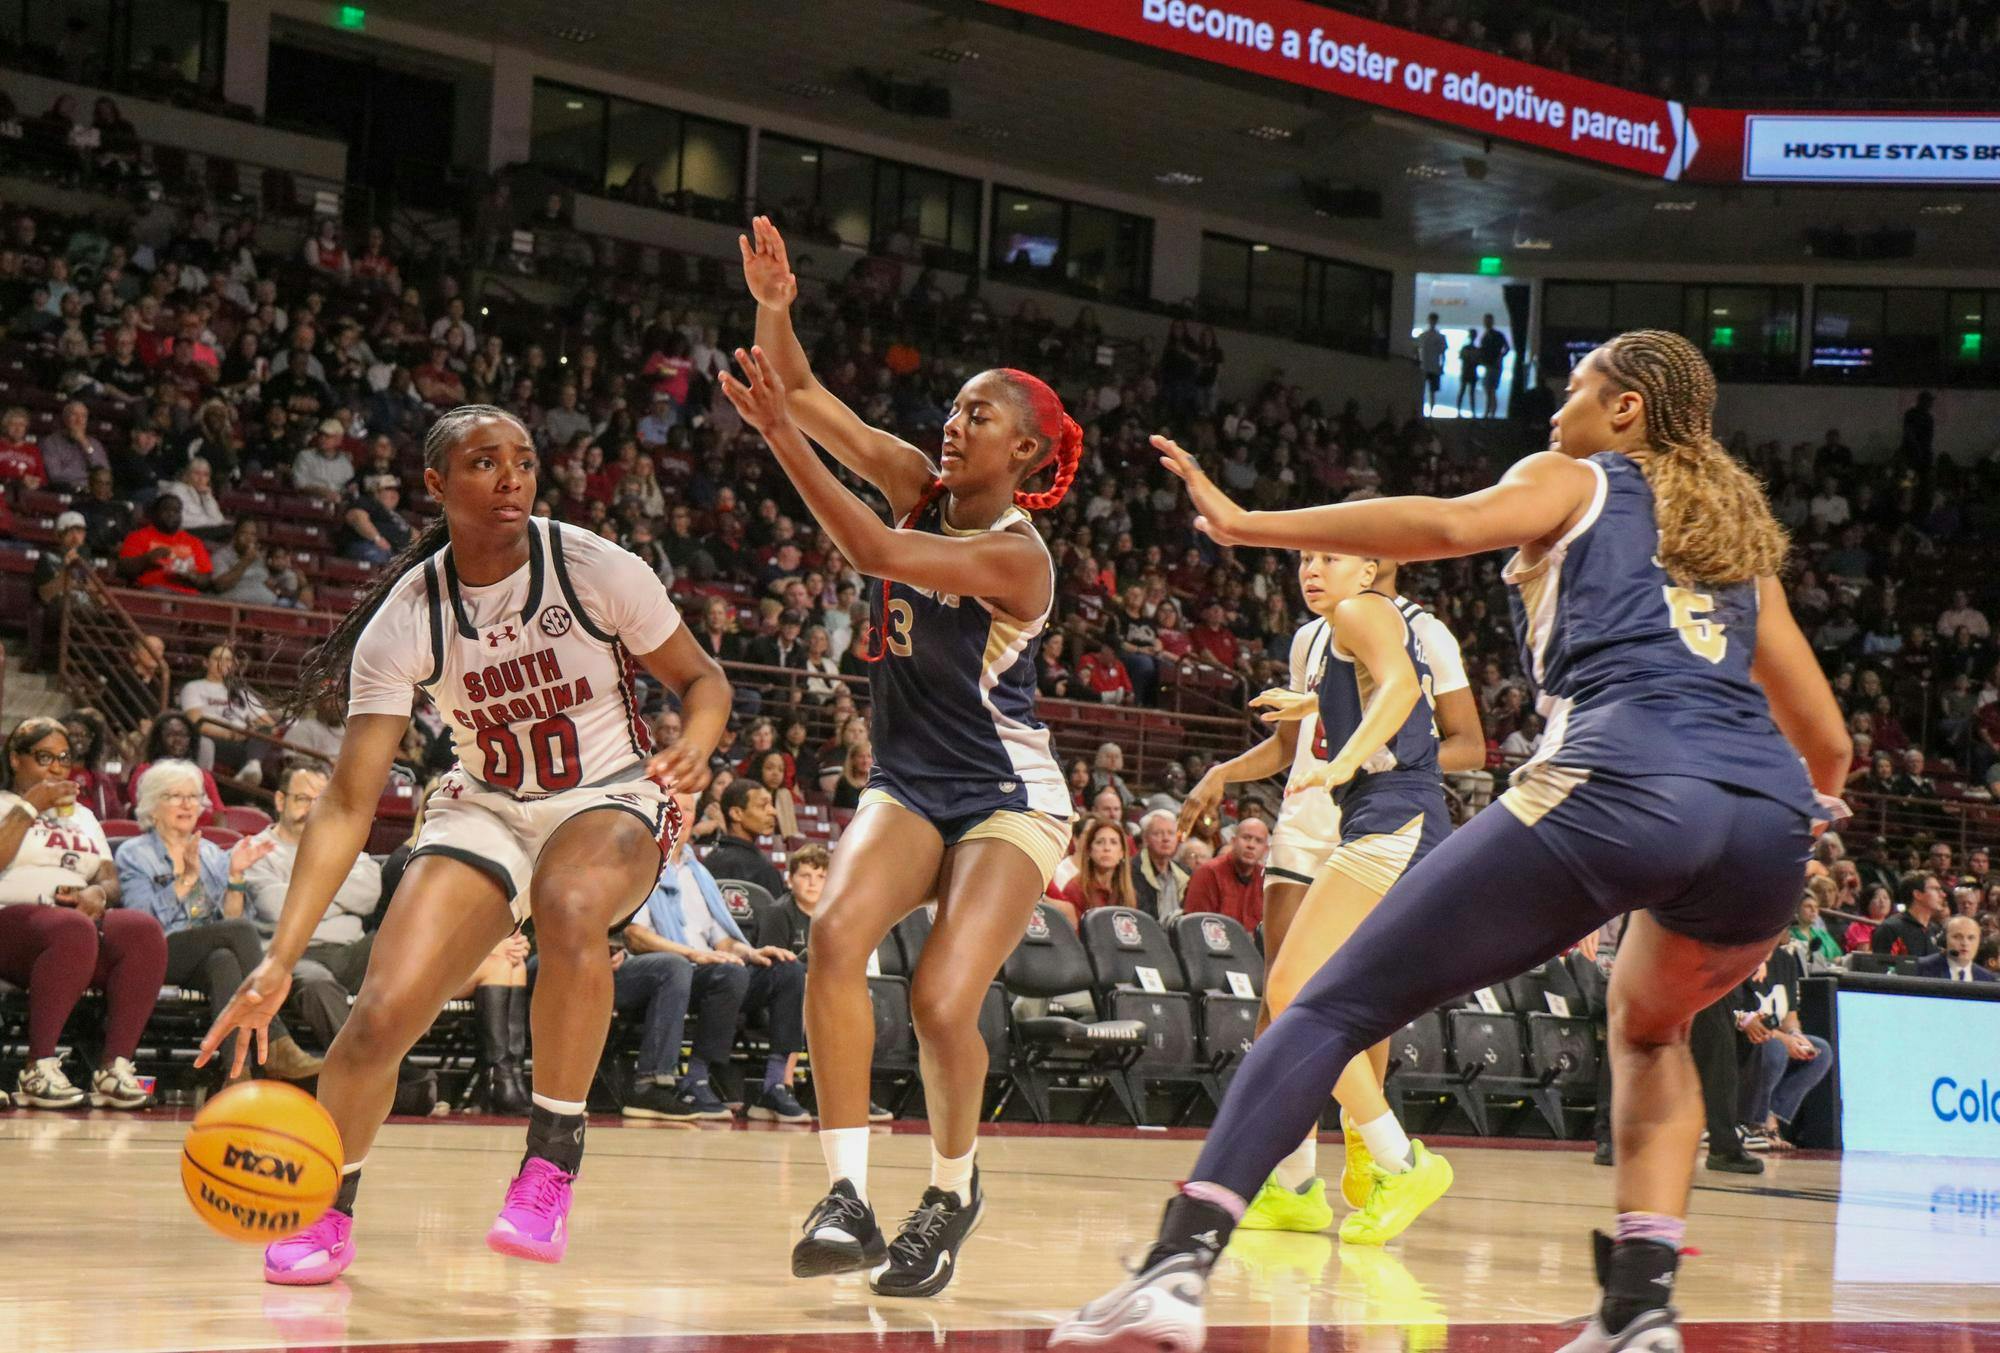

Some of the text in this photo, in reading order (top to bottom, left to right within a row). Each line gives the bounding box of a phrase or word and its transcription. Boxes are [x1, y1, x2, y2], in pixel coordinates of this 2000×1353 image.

[1142, 0, 1666, 154] Become a foster or adoptive parent.
[1784, 143, 1881, 159] HUSTLE
[1885, 144, 1968, 160] STATS
[463, 647, 563, 703] SOUTH
[452, 676, 594, 732] CAROLINA
[476, 712, 583, 792] 00
[222, 1144, 304, 1185] NCAA
